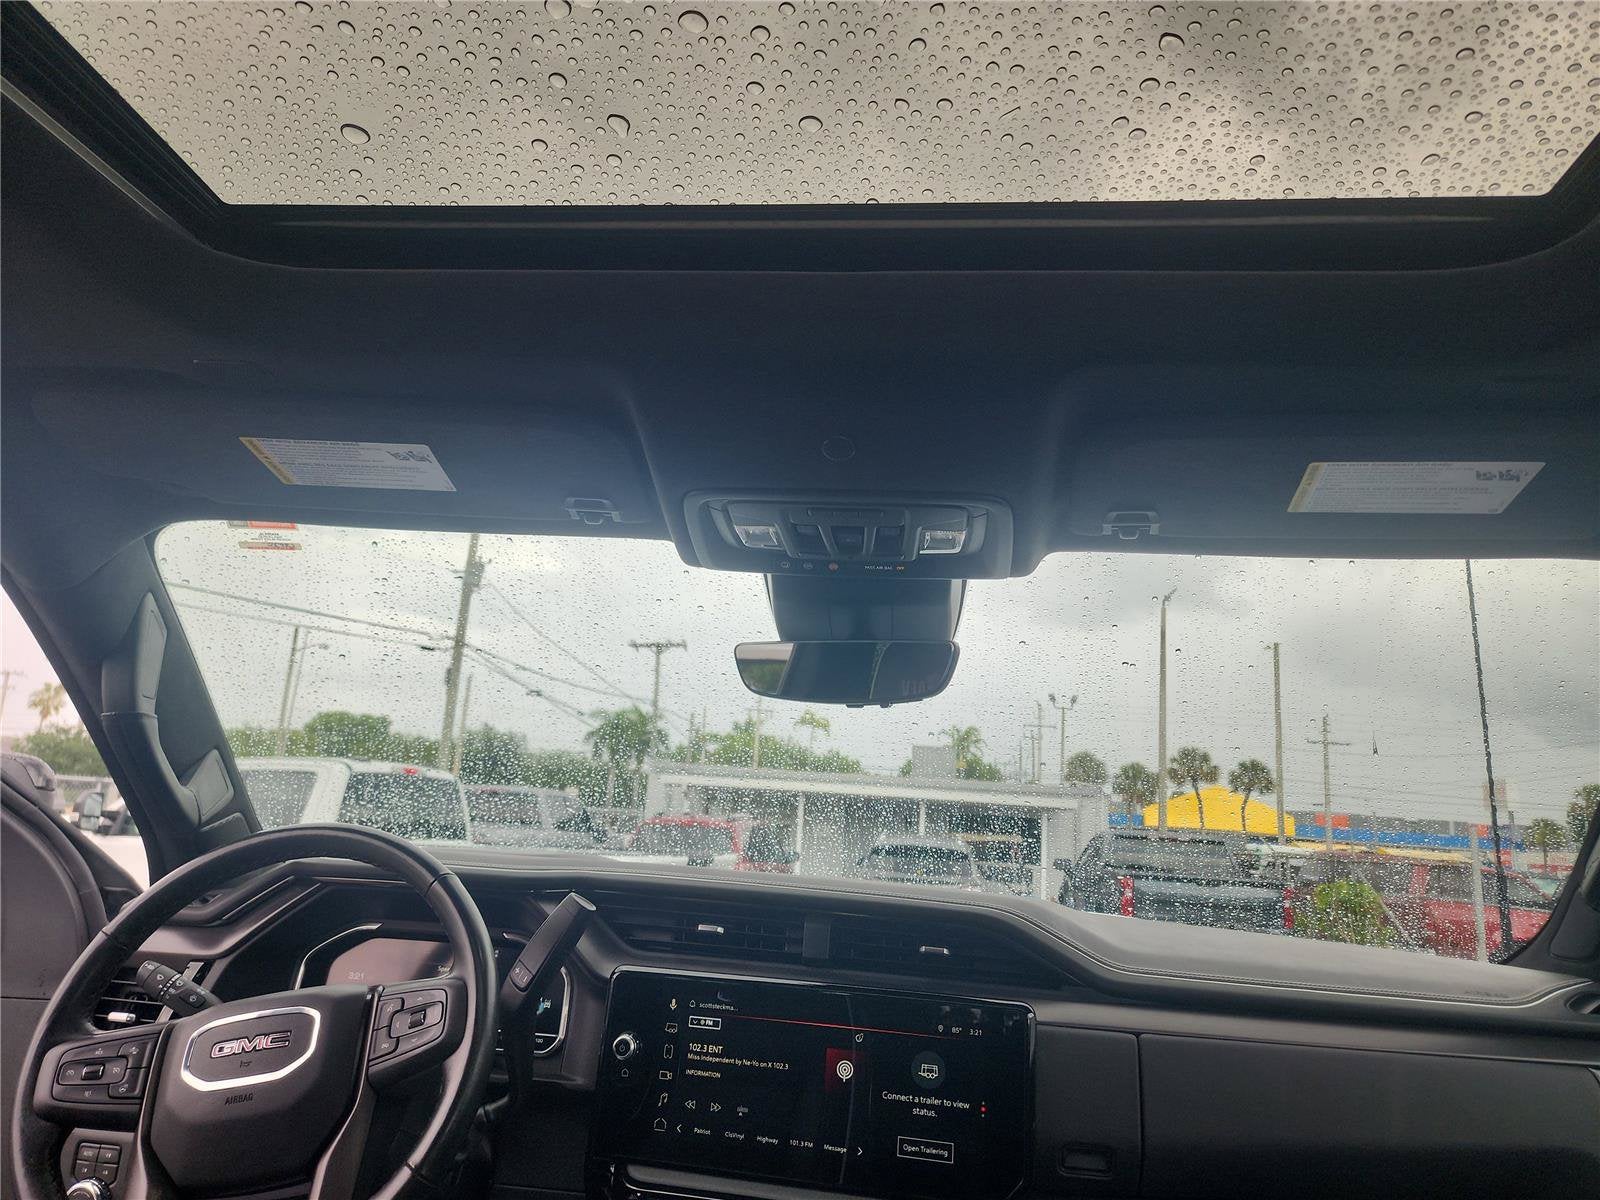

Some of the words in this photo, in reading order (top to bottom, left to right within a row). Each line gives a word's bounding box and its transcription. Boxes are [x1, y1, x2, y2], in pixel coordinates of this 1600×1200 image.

[969, 1028, 983, 1036] 3:21
[210, 1030, 292, 1059] GMC
[689, 1043, 708, 1053] 102.3
[708, 1045, 724, 1054] ENT
[687, 1053, 700, 1061] Miss
[701, 1055, 734, 1064] Independent
[735, 1058, 742, 1066] by
[742, 1058, 759, 1067] Ne-Yo
[773, 1062, 789, 1070] 102.3
[686, 1070, 720, 1078] INFORMATION
[224, 1093, 253, 1106] AIRBAG
[882, 1091, 913, 1103] Connect
[920, 1096, 942, 1107] trailer
[943, 1099, 952, 1107] to
[952, 1100, 970, 1110] view
[912, 1106, 938, 1117] status.
[694, 1127, 711, 1135] Patriot
[756, 1135, 779, 1145] Highway
[789, 1139, 804, 1148] 101.3
[804, 1141, 814, 1149] FM
[824, 1143, 847, 1153] Message
[902, 1143, 920, 1154] Open
[920, 1145, 949, 1157] Trailering
